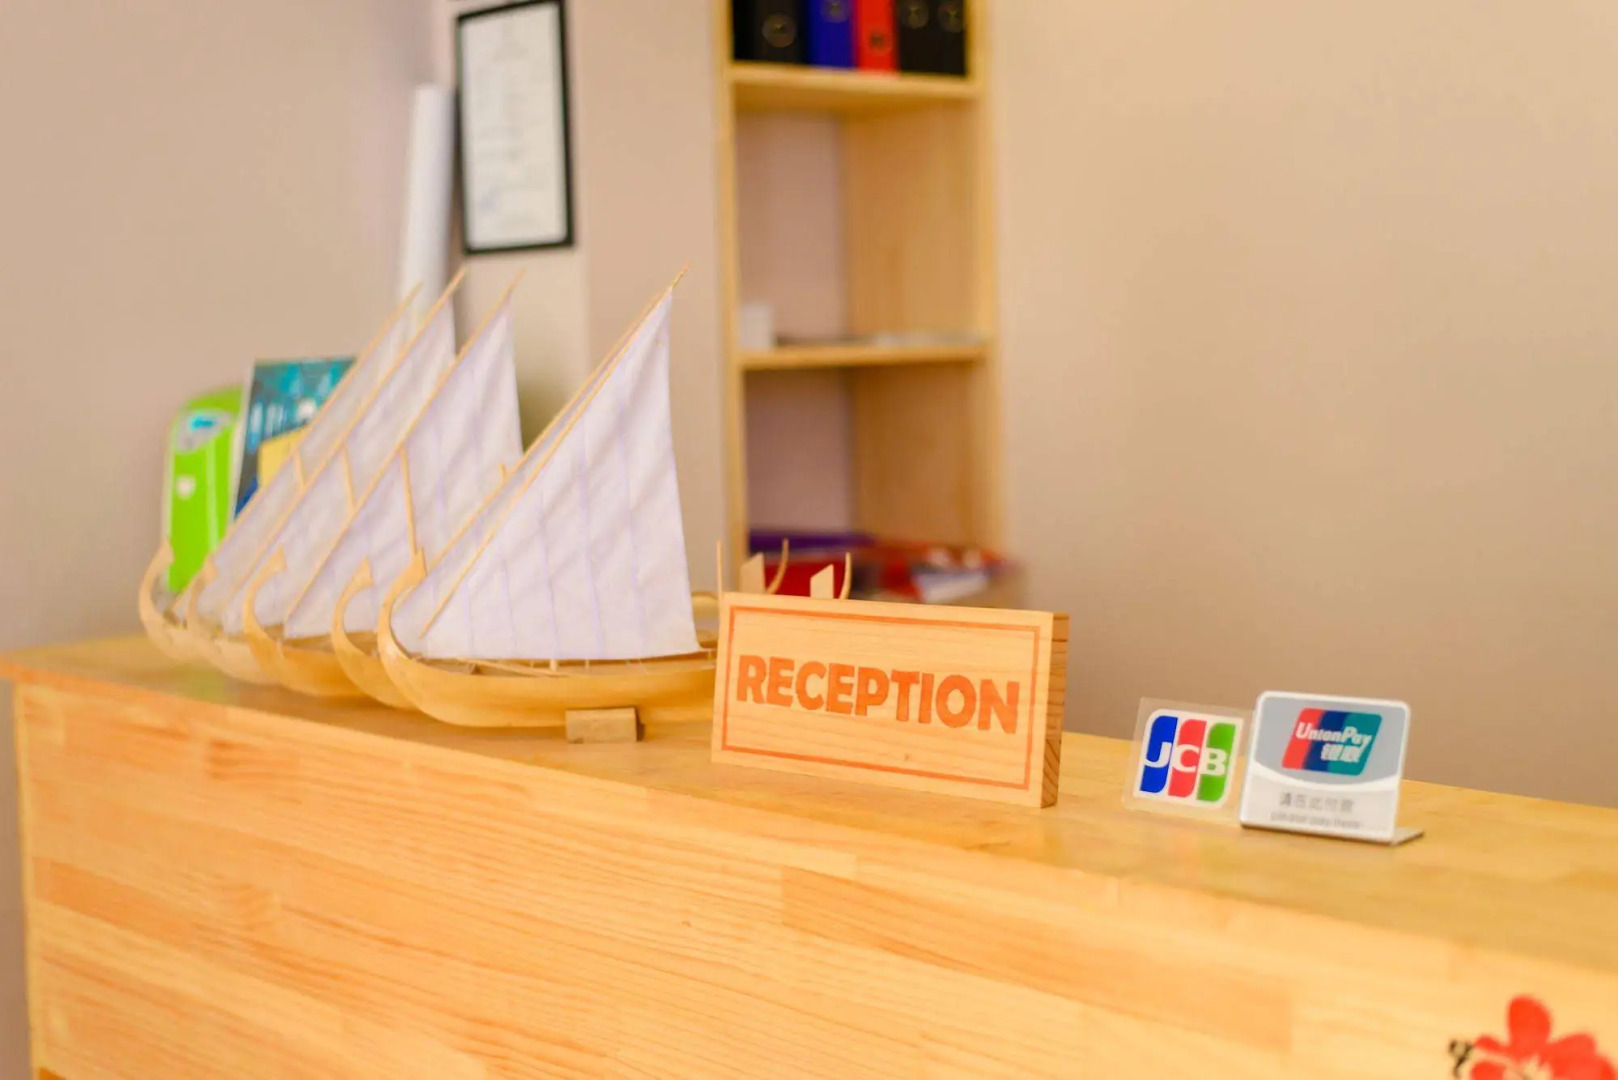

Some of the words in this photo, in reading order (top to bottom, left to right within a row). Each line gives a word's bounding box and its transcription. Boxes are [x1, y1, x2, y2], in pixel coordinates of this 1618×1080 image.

[736, 655, 1021, 734] RECEPTION
[1296, 721, 1372, 750] UnionPay
[1143, 741, 1228, 777] JCB
